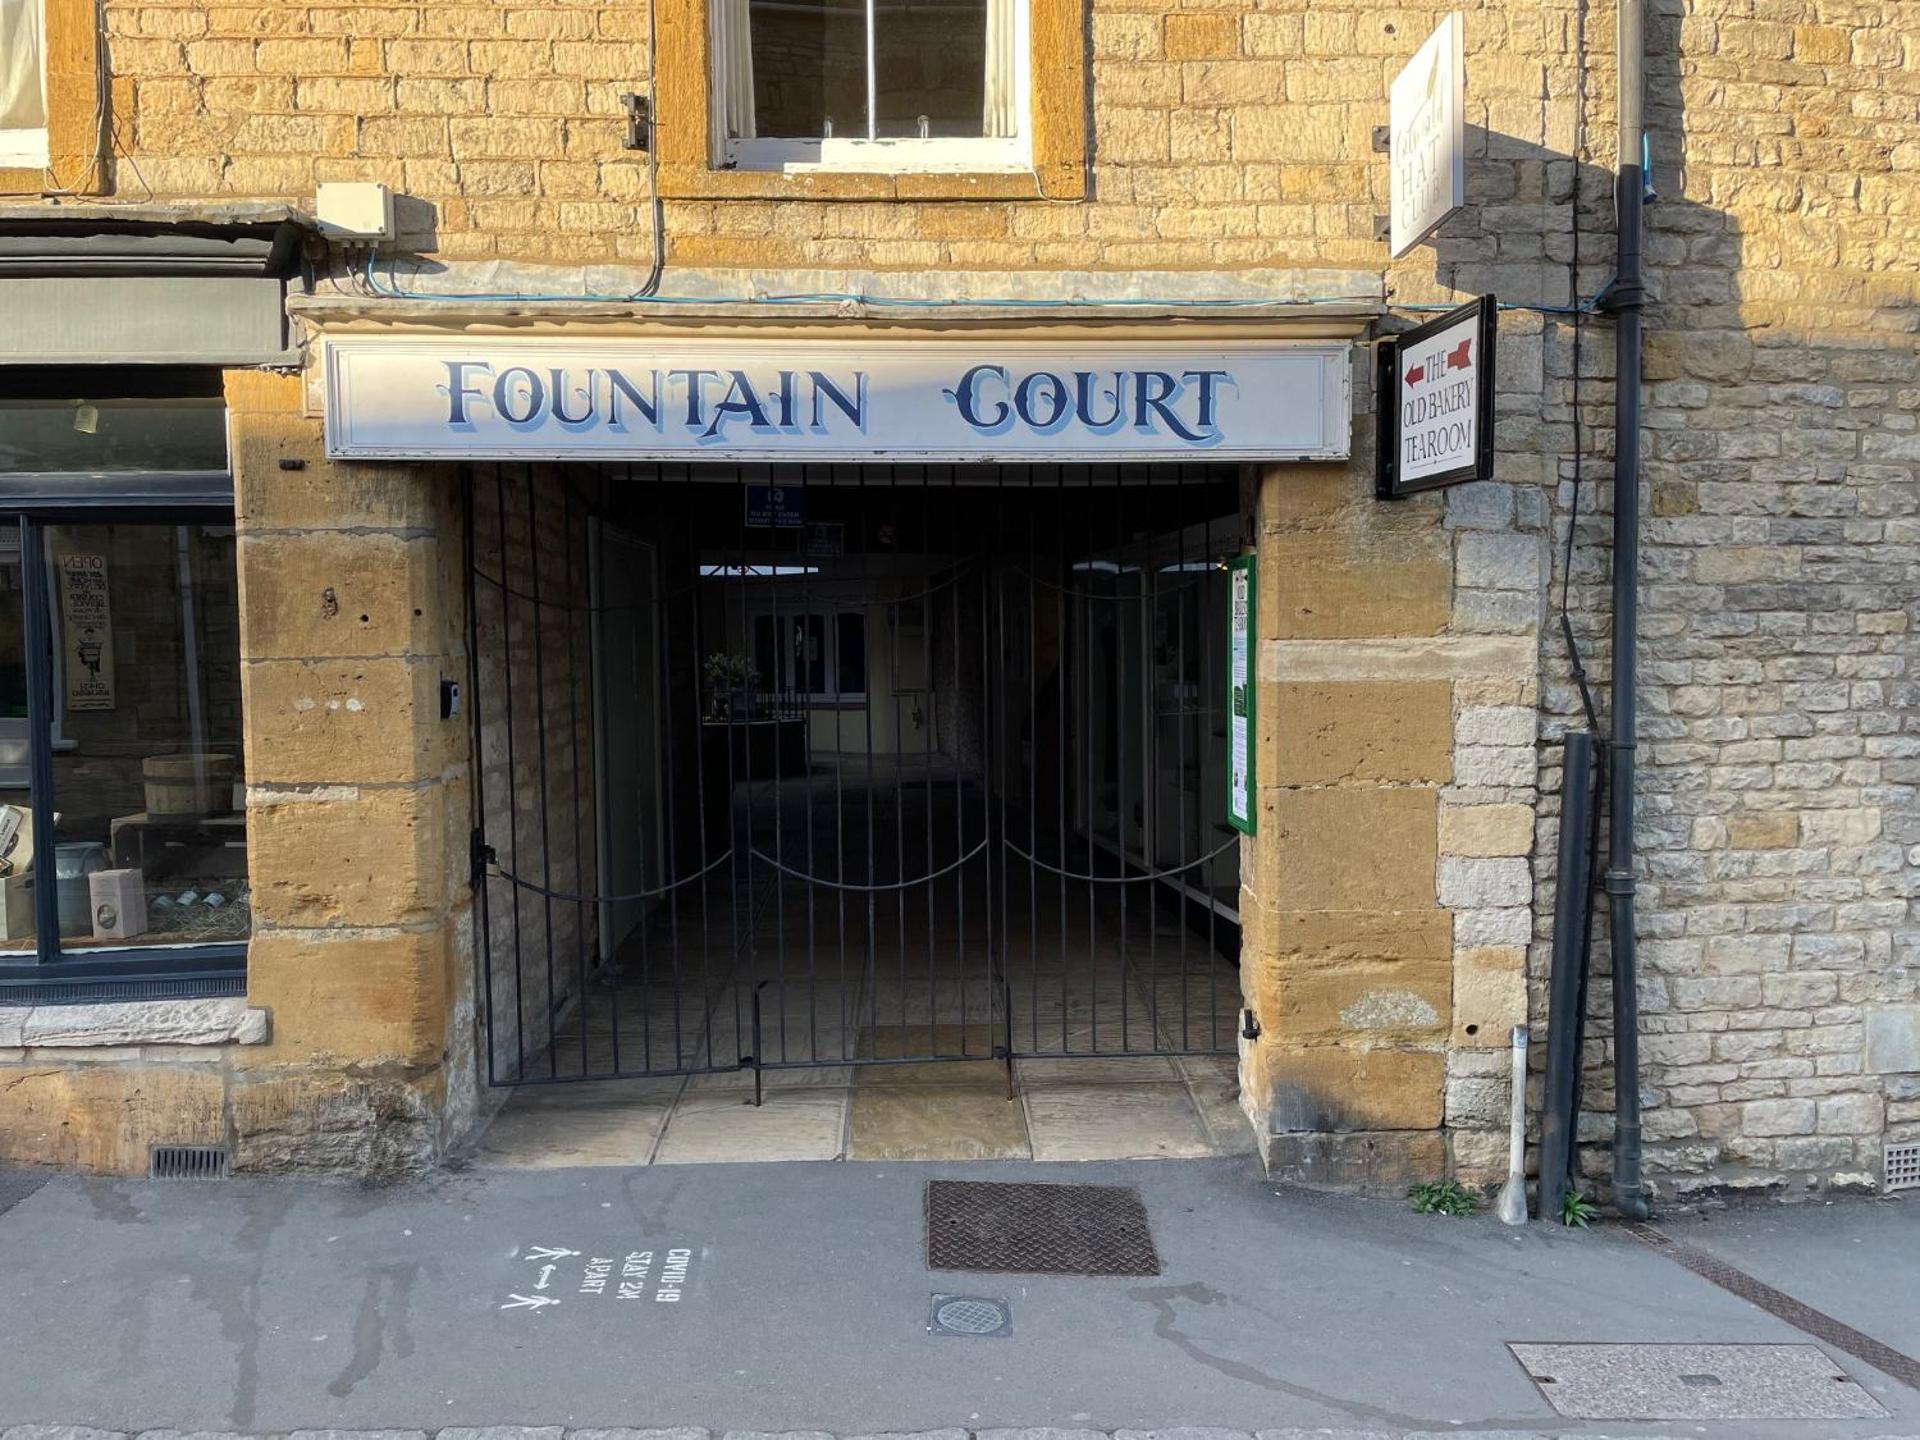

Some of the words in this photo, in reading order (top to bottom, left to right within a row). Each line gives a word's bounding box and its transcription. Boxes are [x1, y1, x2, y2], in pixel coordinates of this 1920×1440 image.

[1400, 136, 1440, 203] HAT
[1401, 176, 1441, 230] CLUB
[1426, 350, 1447, 384] THE
[436, 361, 866, 441] FOUNTAIN
[942, 364, 1232, 445] COURT
[1403, 395, 1427, 428] OLD
[1429, 377, 1474, 420] BAKERY
[1405, 420, 1473, 464] TEAROOM
[578, 1257, 614, 1295] APART
[622, 1251, 653, 1279] STAY
[655, 1248, 691, 1302] COVID-19
[616, 1281, 644, 1300] 2M
